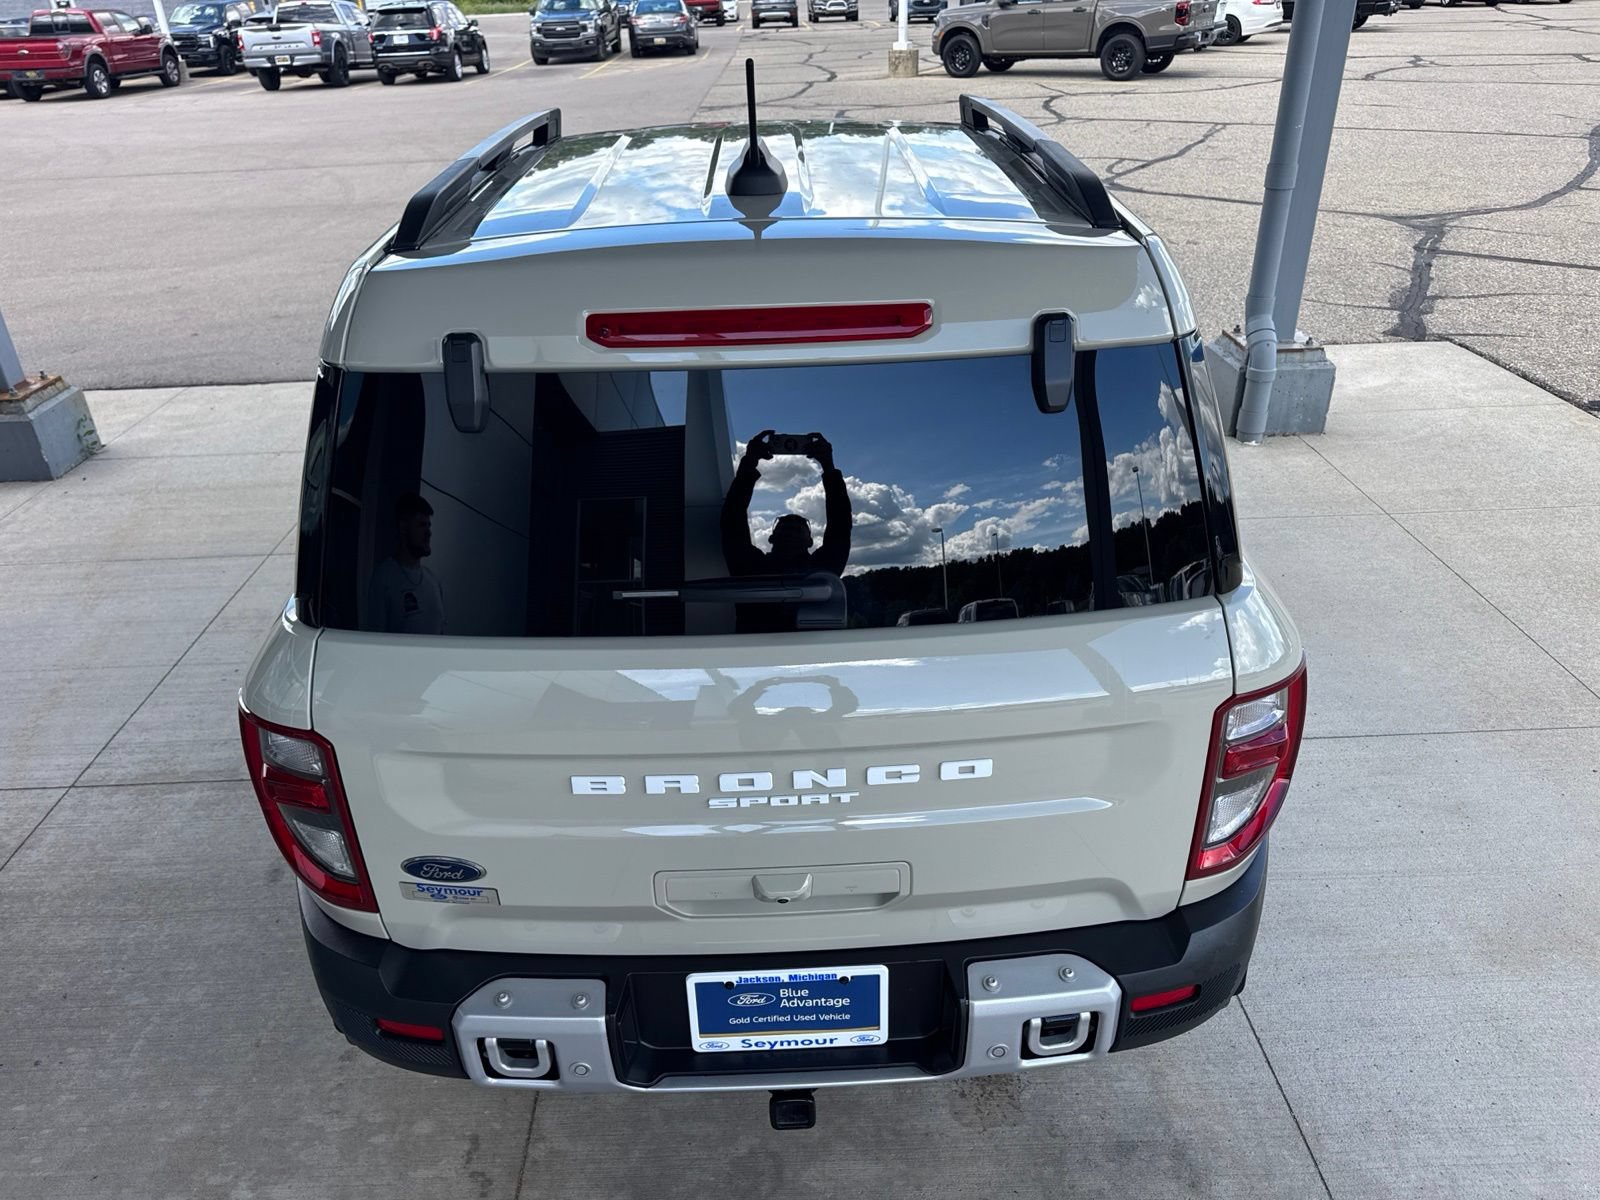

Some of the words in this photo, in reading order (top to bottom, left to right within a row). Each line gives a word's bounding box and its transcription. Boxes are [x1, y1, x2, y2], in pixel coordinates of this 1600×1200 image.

[570, 758, 993, 795] BRONCO
[707, 791, 860, 809] SPORT
[420, 863, 465, 880] Ford
[416, 883, 484, 897] Seymour
[735, 975, 785, 984] Jackson,
[788, 973, 838, 982] Michigan
[736, 992, 767, 1005] Ford
[779, 988, 809, 998] Blue
[779, 997, 850, 1008] Advantage
[728, 1017, 751, 1025] Gold
[752, 1015, 791, 1023] Certified
[793, 1014, 816, 1022] Used
[818, 1013, 851, 1021] Vehicle
[741, 1037, 839, 1050] Seymour
